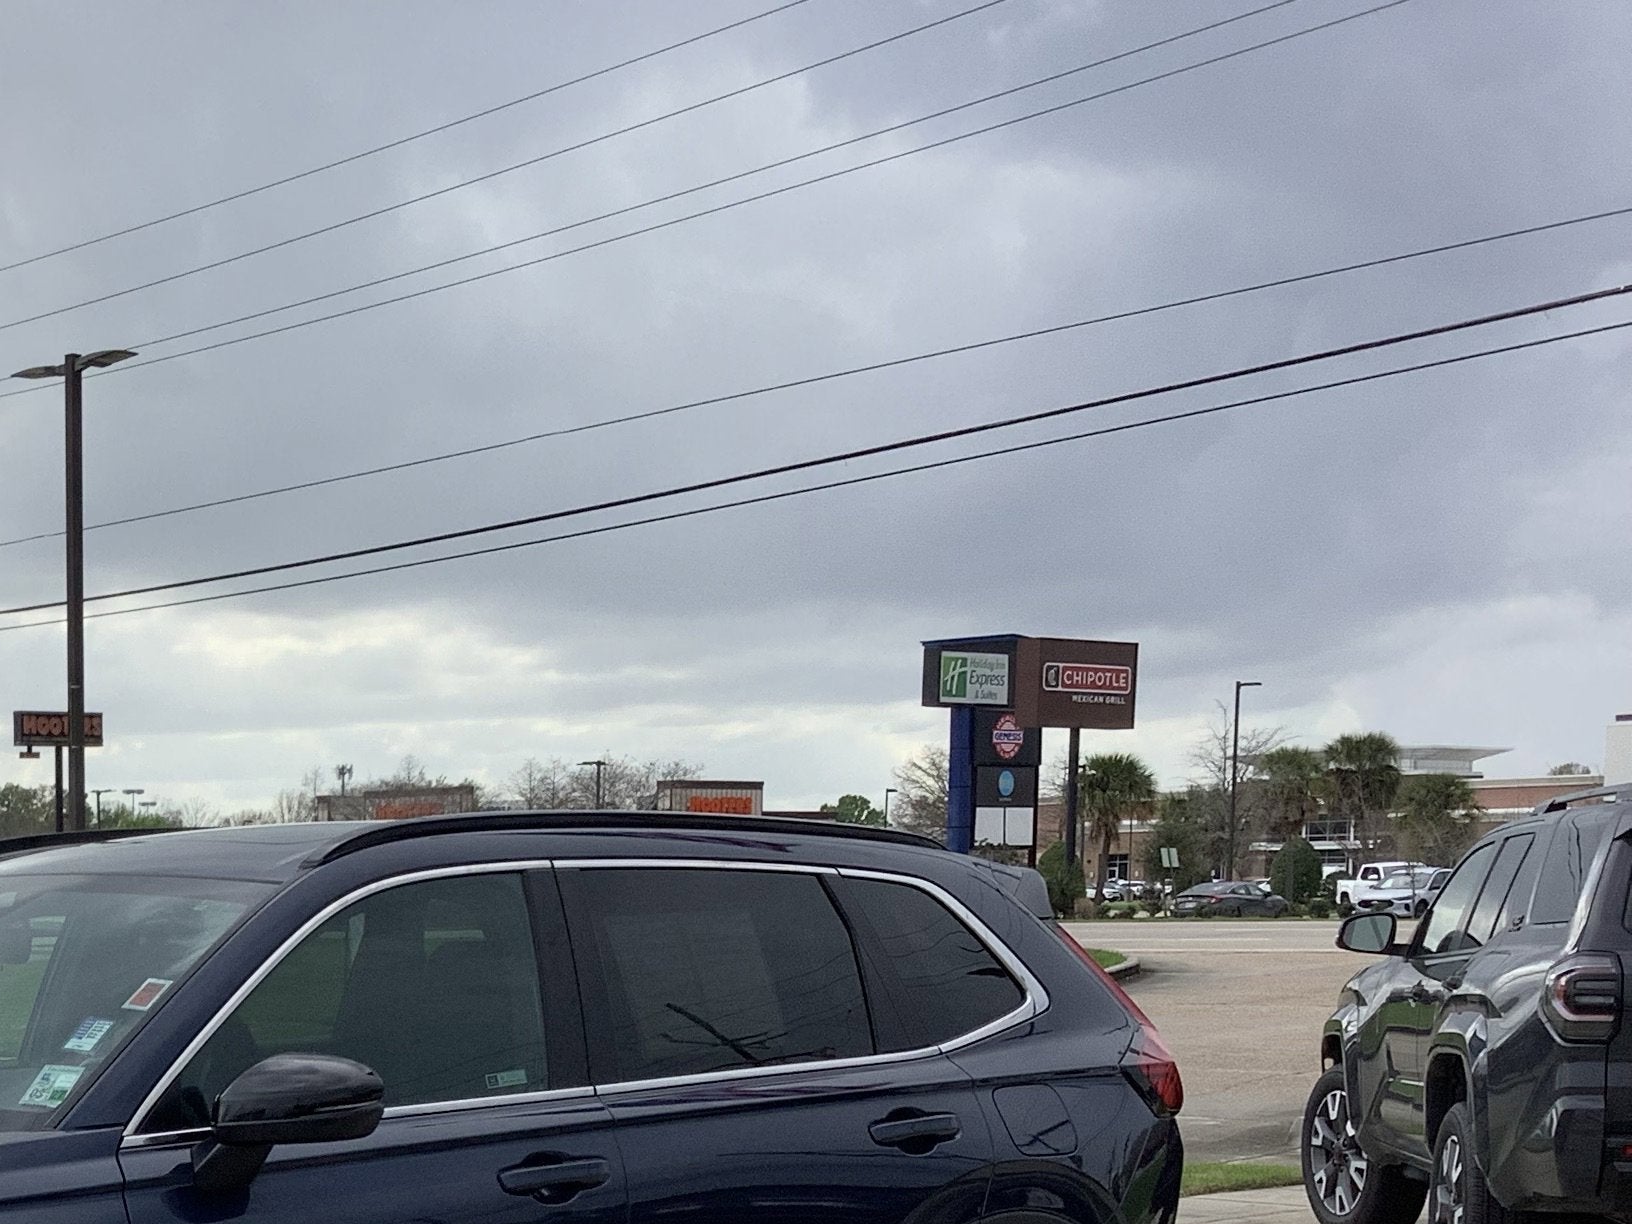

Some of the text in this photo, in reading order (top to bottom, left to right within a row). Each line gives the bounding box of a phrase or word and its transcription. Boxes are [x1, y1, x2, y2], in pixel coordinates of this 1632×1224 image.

[969, 670, 1006, 688] Express
[1063, 670, 1127, 687] CHIPOTLE
[1072, 694, 1126, 705] MEXICAN GRILL
[23, 715, 101, 736] HOOTRS
[994, 731, 1022, 741] GENESIS
